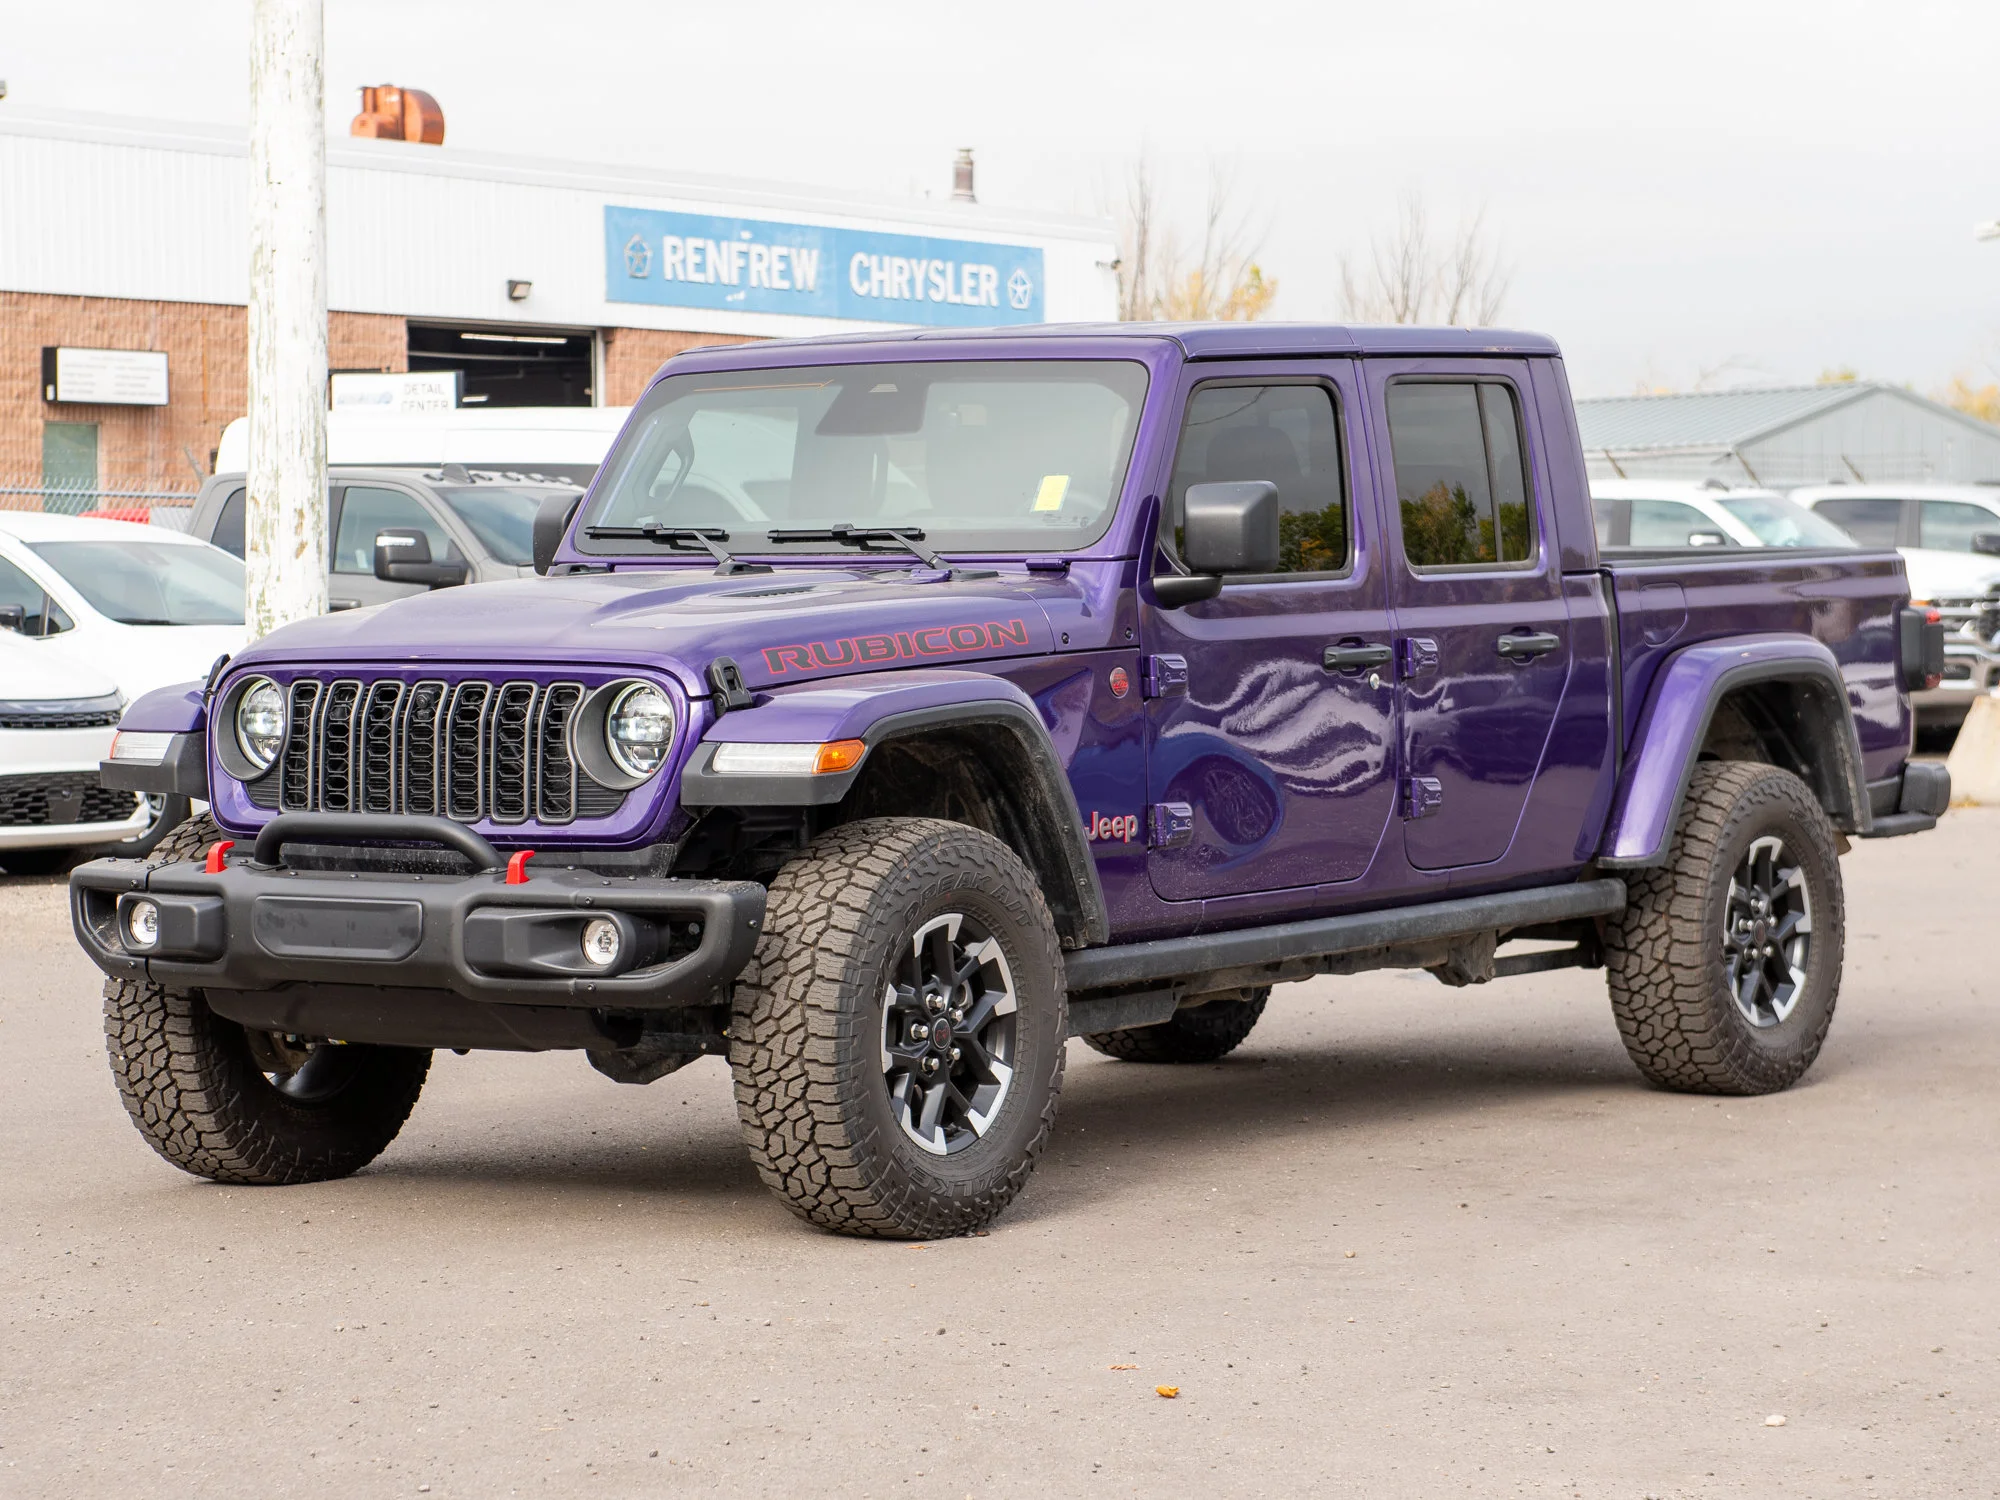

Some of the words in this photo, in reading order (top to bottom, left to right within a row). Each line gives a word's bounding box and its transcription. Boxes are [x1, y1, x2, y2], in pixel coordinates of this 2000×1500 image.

[662, 234, 818, 293] RENFREW
[849, 251, 999, 309] CHRYSLER
[403, 383, 445, 396] DETAIL
[761, 618, 1029, 675] RUBICON
[1084, 811, 1138, 844] Jeep
